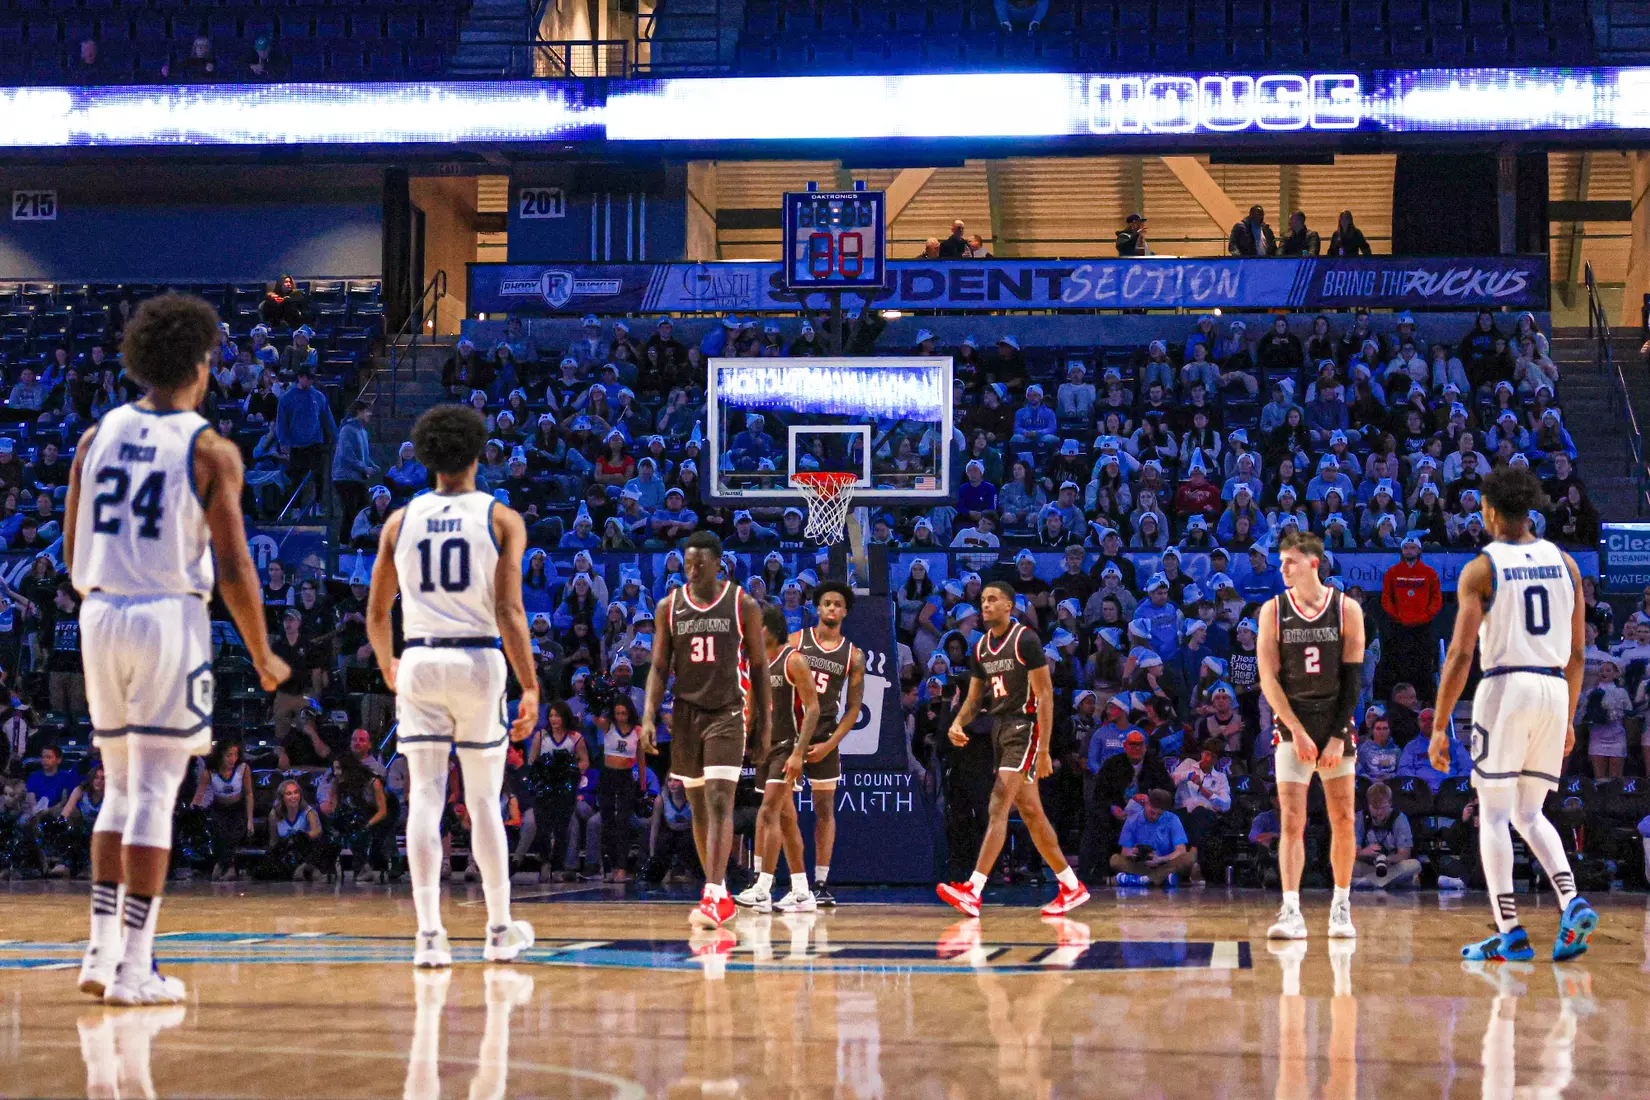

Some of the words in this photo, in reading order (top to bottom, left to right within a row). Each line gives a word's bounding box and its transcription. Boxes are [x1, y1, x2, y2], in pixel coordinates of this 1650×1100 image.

[15, 193, 55, 217] 215
[522, 191, 562, 215] 201
[1063, 263, 1241, 304] SECTION
[1322, 270, 1377, 296] BRING
[1381, 270, 1411, 296] THE
[1405, 267, 1531, 298] RUCKUS
[94, 466, 166, 539] 24
[417, 537, 471, 592] 10
[1524, 585, 1551, 635] 0
[677, 618, 731, 635] BROWN
[1283, 627, 1338, 643] BROWN
[690, 636, 716, 662] 31
[1304, 646, 1320, 674] 2
[854, 773, 912, 787] COUNTY
[798, 791, 913, 814] HALTH
